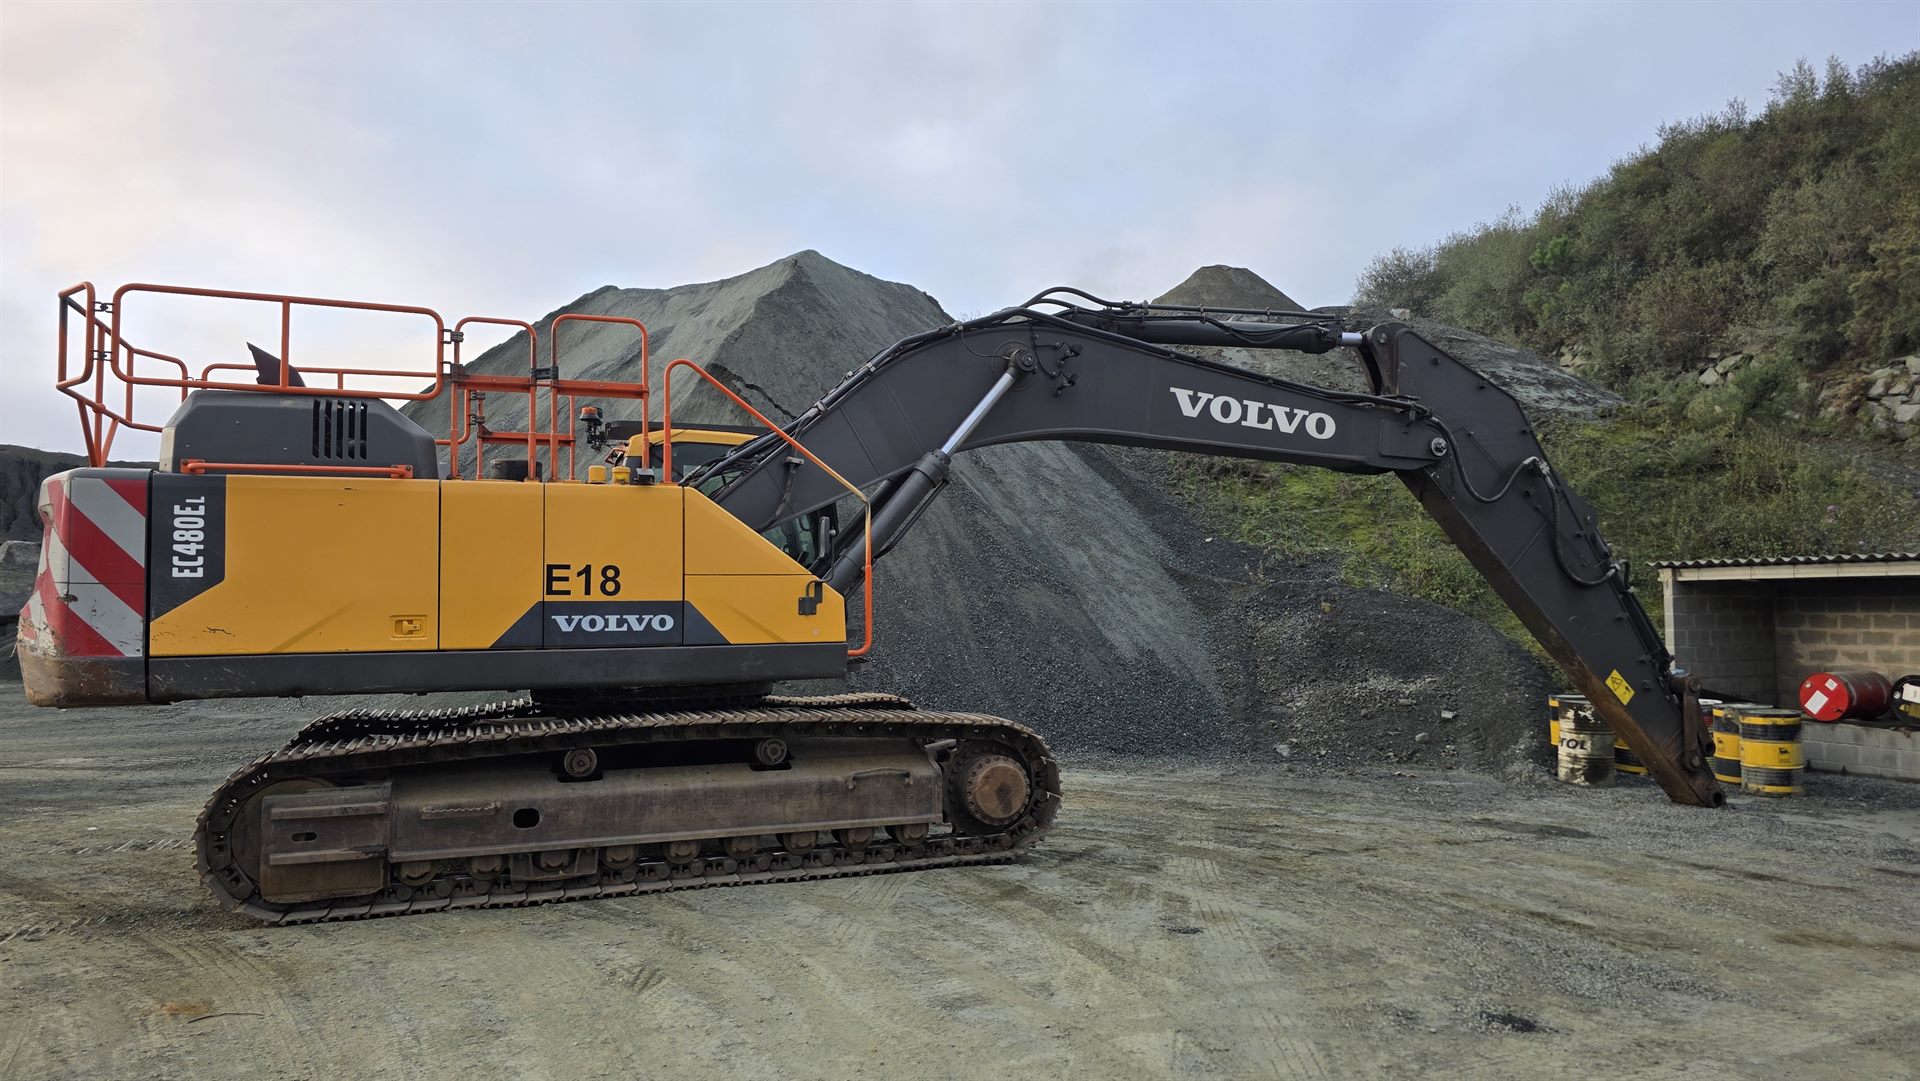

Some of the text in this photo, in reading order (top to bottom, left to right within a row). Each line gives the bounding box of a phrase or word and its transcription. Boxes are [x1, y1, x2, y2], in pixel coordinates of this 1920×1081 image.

[1170, 387, 1336, 440] VOLVO
[546, 564, 621, 596] E18
[552, 615, 674, 632] VOLVO
